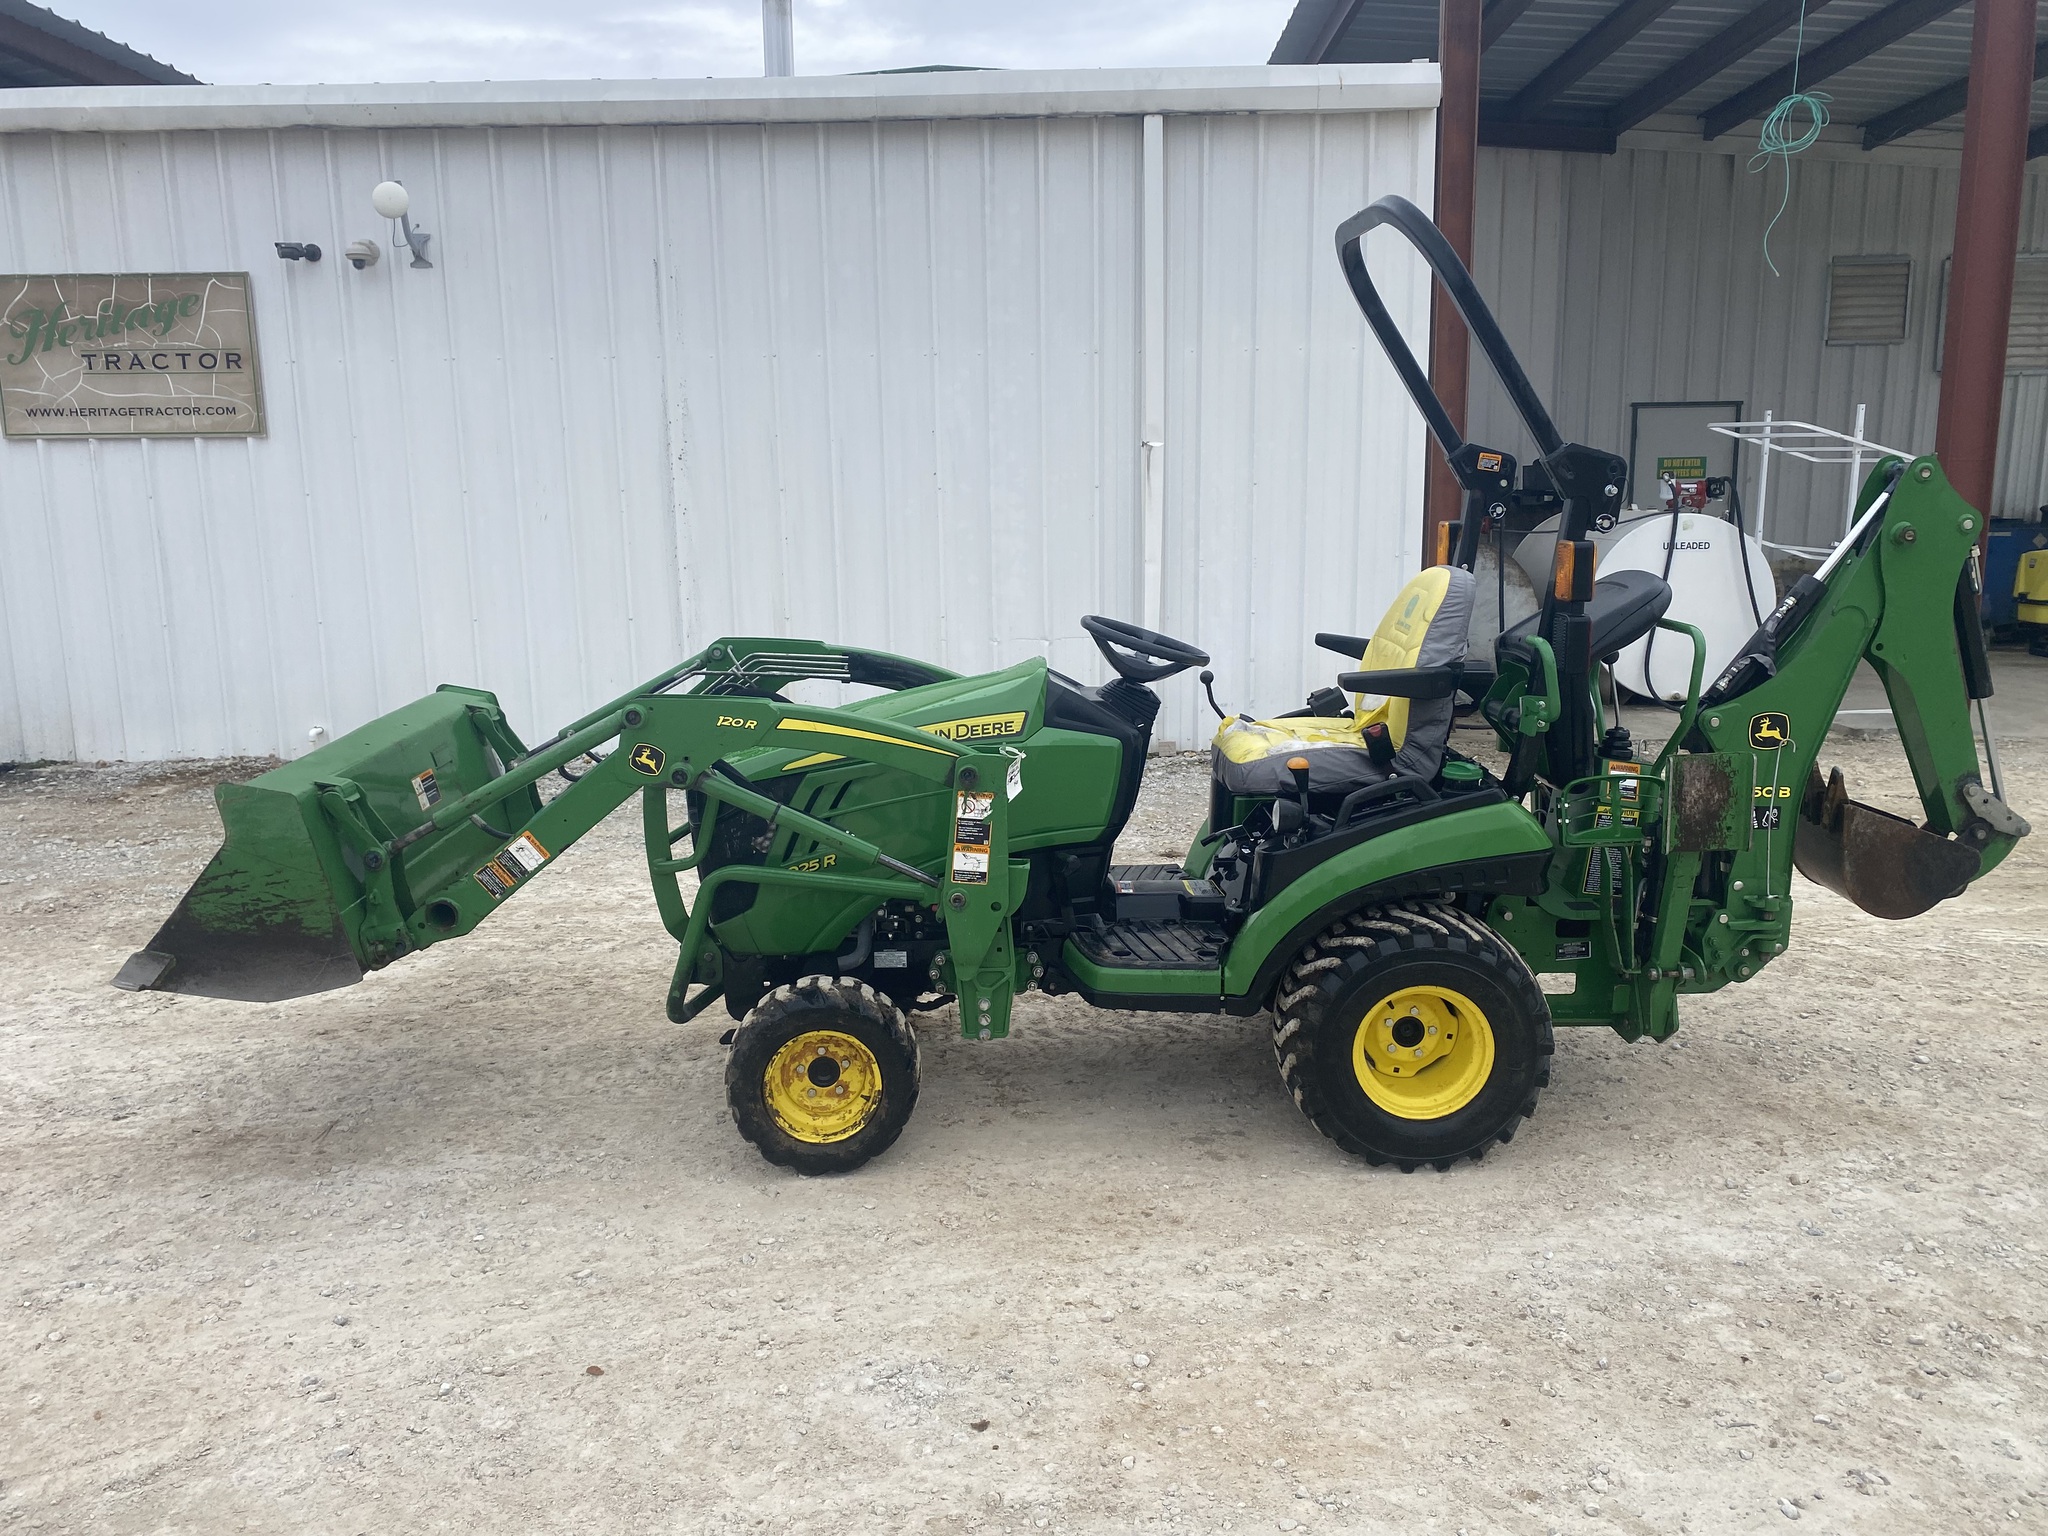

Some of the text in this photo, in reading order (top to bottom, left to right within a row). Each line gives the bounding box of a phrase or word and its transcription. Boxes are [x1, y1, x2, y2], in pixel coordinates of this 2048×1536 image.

[7, 293, 200, 365] Heritage
[81, 352, 242, 371] TRACTOR
[25, 406, 237, 417] WWW.HERITAGETRACTOR.COM
[1663, 458, 1700, 467] DO NOT ENTER
[1691, 468, 1704, 476] ONLY
[1662, 541, 1711, 550] ULEADED
[716, 715, 744, 727] 120
[956, 721, 1015, 738] DEERE
[960, 846, 989, 854] WARNING
